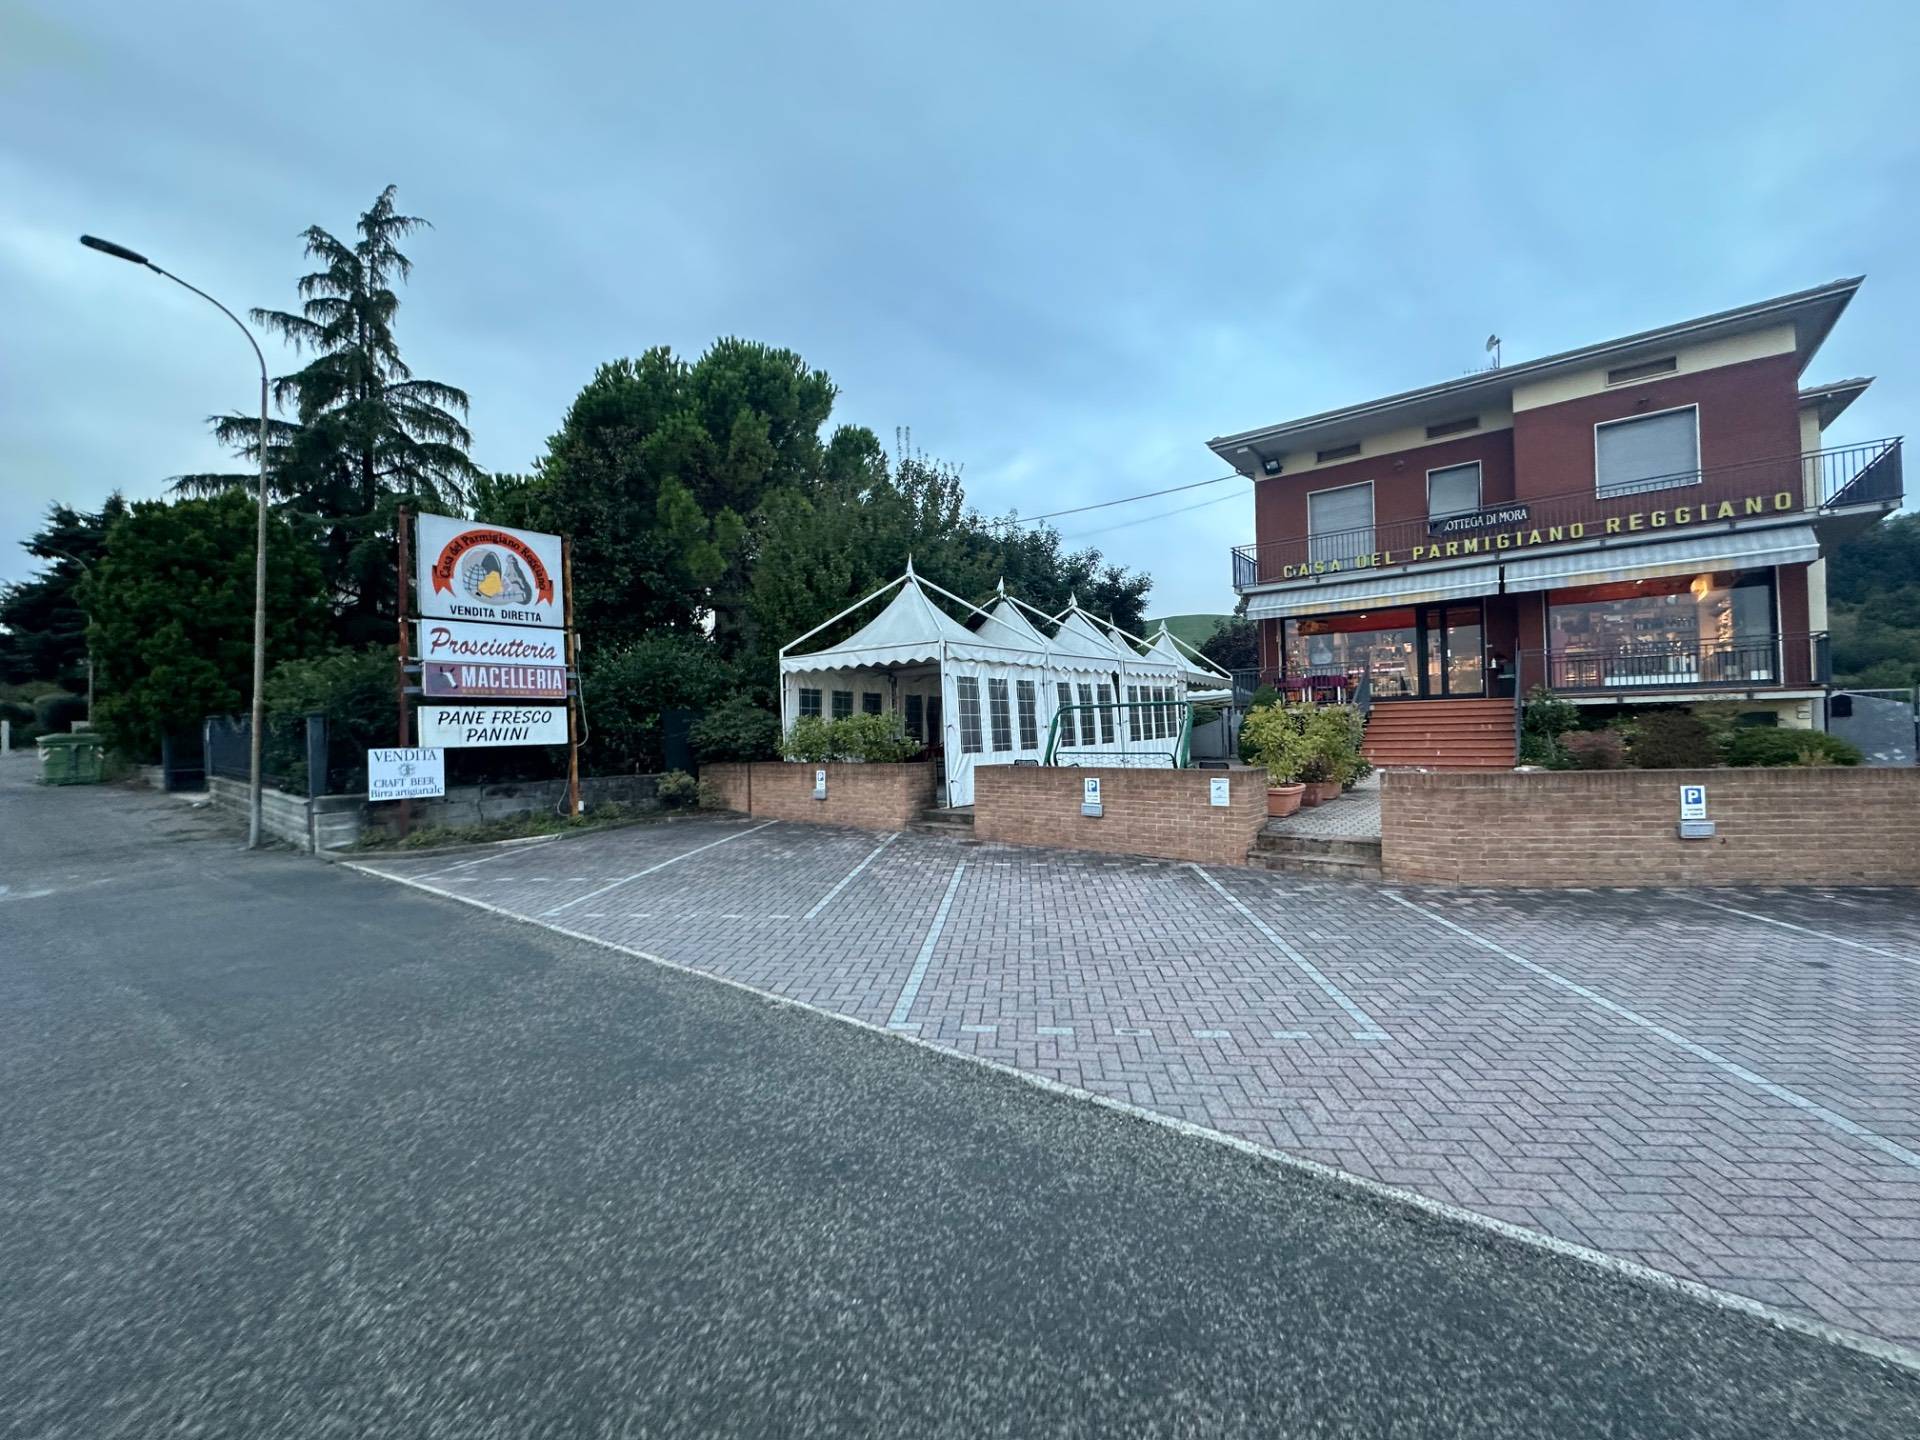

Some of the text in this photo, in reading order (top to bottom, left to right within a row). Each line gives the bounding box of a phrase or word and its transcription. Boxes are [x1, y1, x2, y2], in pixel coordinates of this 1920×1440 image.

[1444, 509, 1527, 531] OTTEGA DI MORA
[1283, 492, 1791, 578] CASA DEL PARMIGIANO REGGIANO
[439, 556, 452, 578] Casa
[451, 541, 463, 555] del
[462, 533, 520, 550] Parmigiano
[450, 605, 542, 622] VENDITA DIRETTA
[430, 627, 558, 659] Prosciutteria
[461, 666, 562, 689] MACELLERIA
[438, 711, 552, 725] PANE FRESCO
[466, 727, 529, 742] PANINI
[374, 750, 437, 762] VENDITA
[374, 777, 435, 788] CRAFT BEER
[371, 789, 393, 798] Birra
